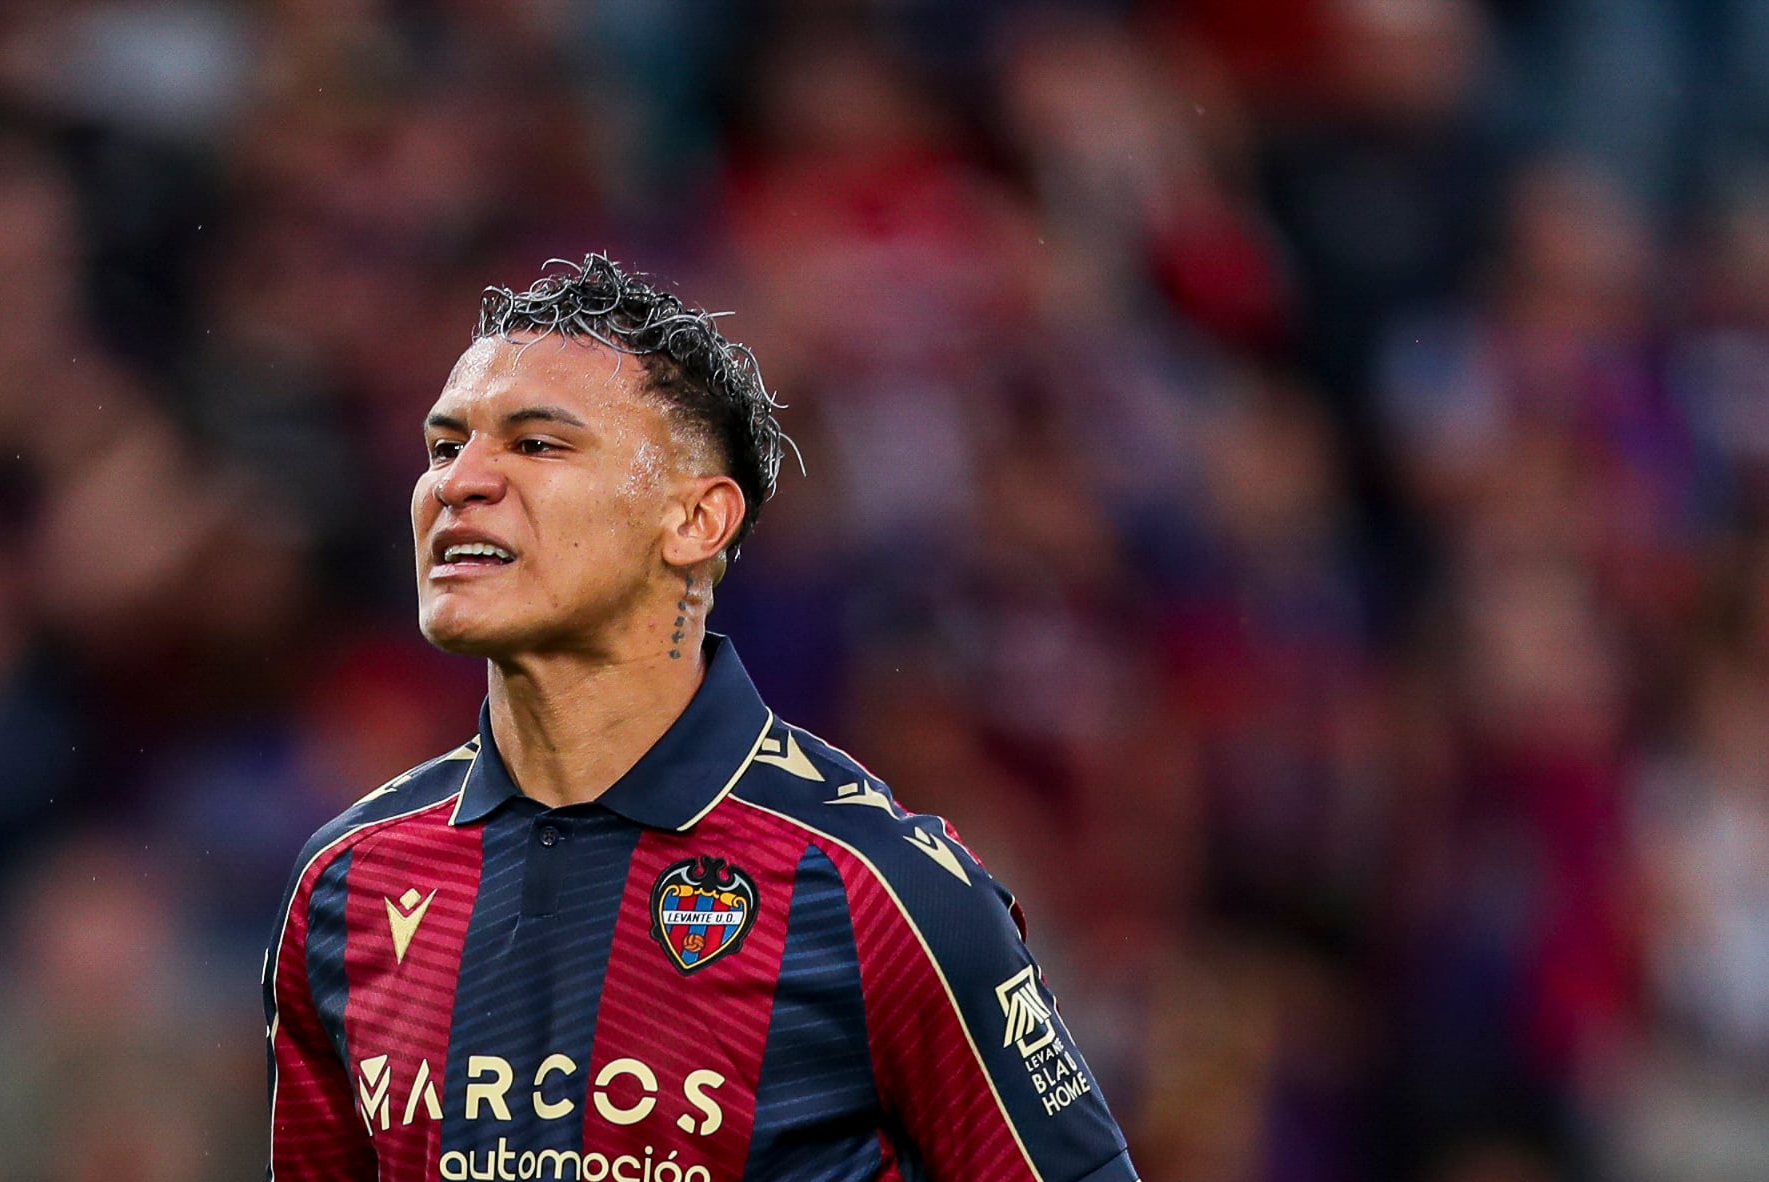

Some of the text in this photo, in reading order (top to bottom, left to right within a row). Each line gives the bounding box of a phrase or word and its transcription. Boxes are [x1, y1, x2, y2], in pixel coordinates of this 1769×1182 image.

[668, 912, 714, 923] LEVANTE
[1032, 1050, 1078, 1094] BLAU
[1042, 1071, 1091, 1116] HOME
[358, 1053, 726, 1137] MARCOS
